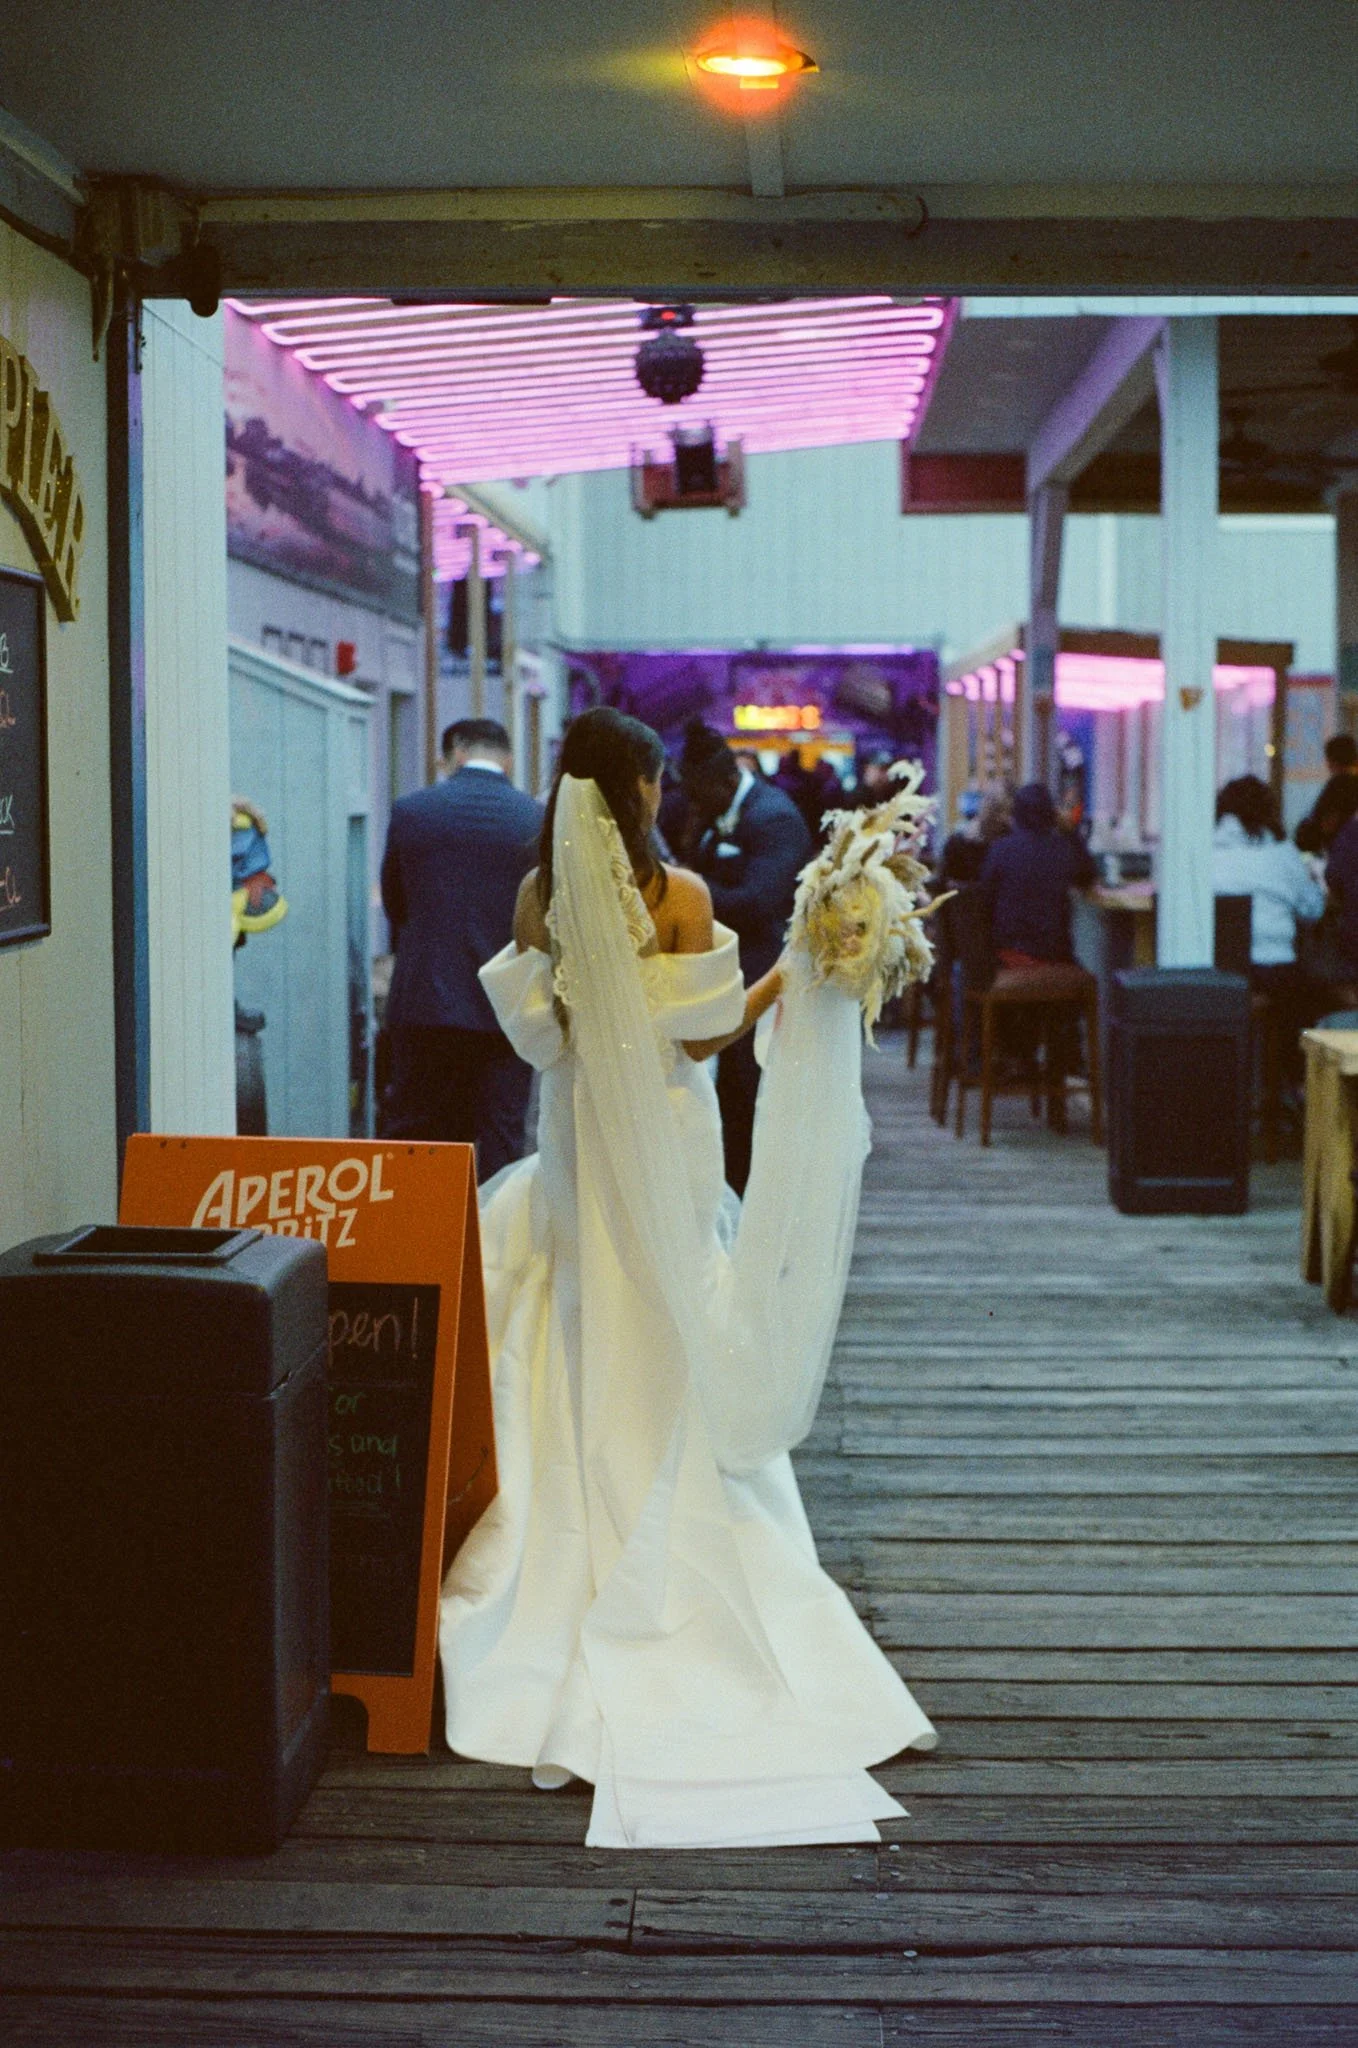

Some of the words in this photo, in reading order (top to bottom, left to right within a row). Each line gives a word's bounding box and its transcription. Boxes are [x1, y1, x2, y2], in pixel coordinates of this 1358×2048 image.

[0, 336, 83, 619] PIER
[190, 1153, 394, 1229] APEROL
[328, 1297, 418, 1367] pen!
[350, 1434, 398, 1459] and
